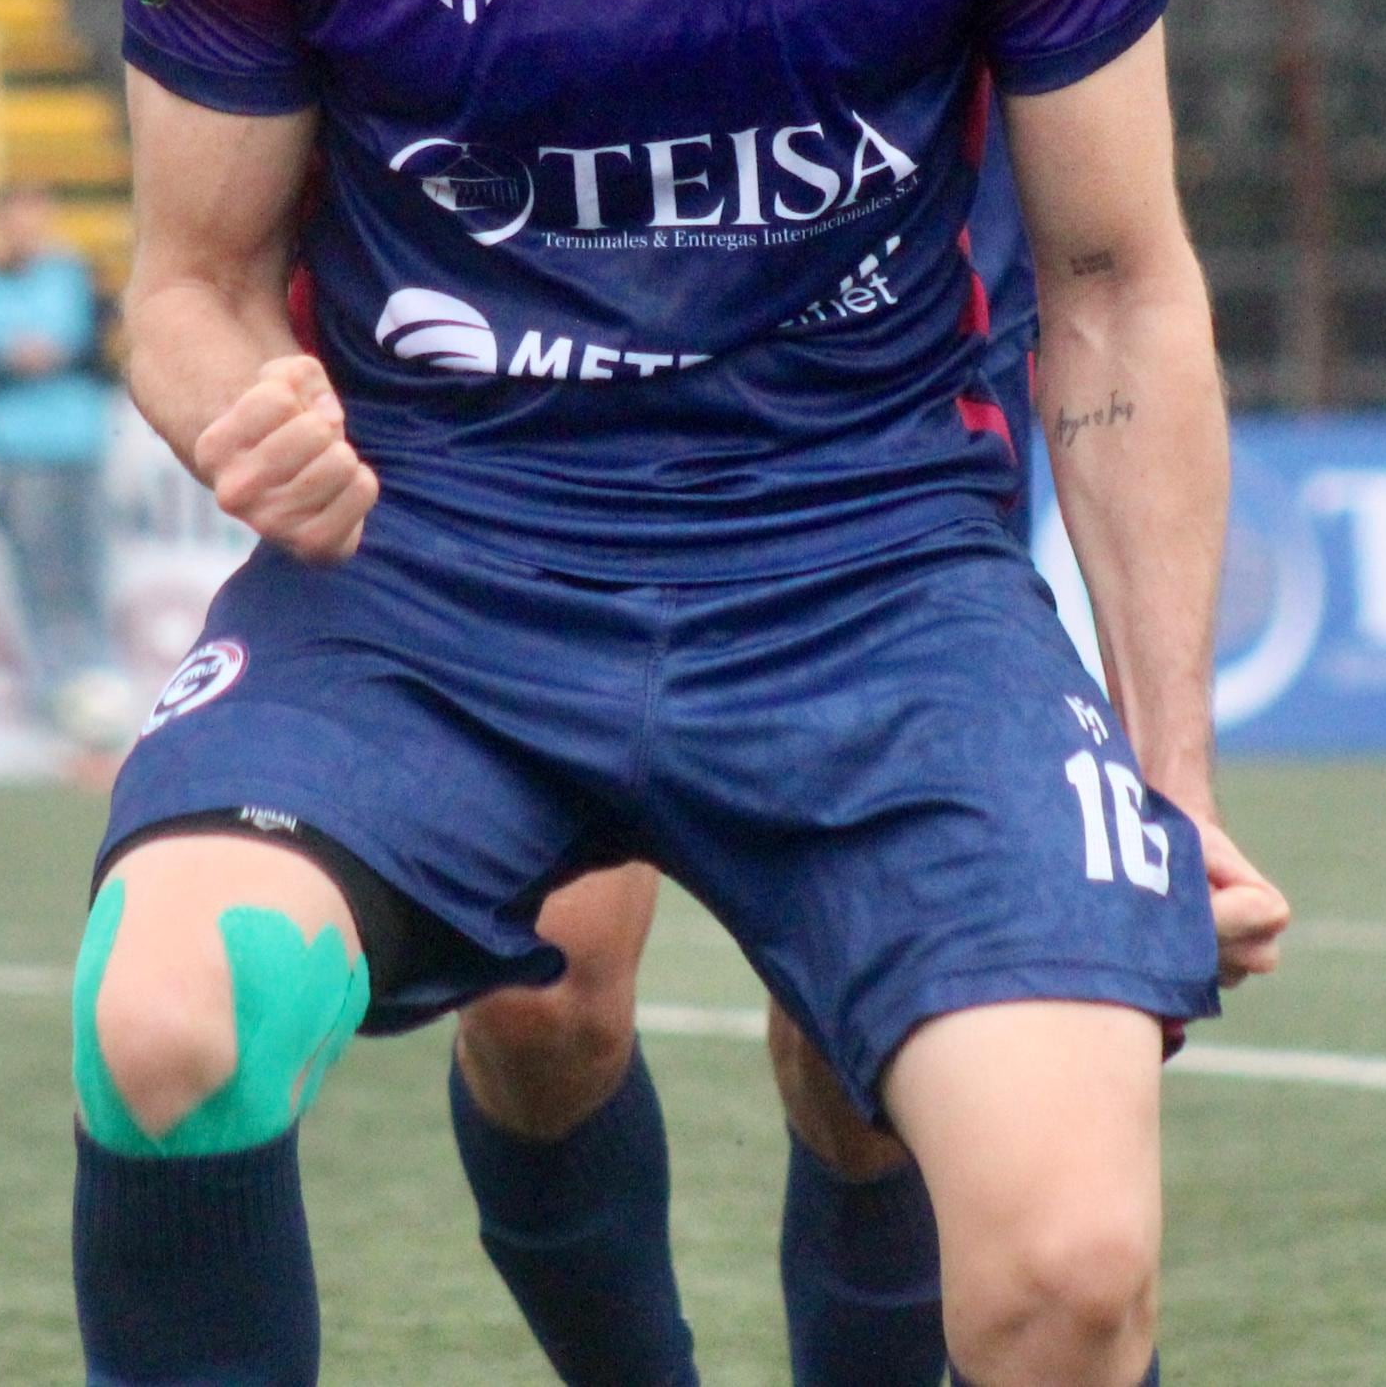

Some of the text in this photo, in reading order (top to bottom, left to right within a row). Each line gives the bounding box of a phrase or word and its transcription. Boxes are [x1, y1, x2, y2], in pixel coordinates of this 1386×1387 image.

[538, 110, 918, 230] TEISA
[541, 231, 648, 249] Terminales
[653, 231, 667, 248] &
[674, 230, 757, 251] Entregas
[764, 196, 892, 246] Internacionales
[1065, 750, 1169, 896] 16
